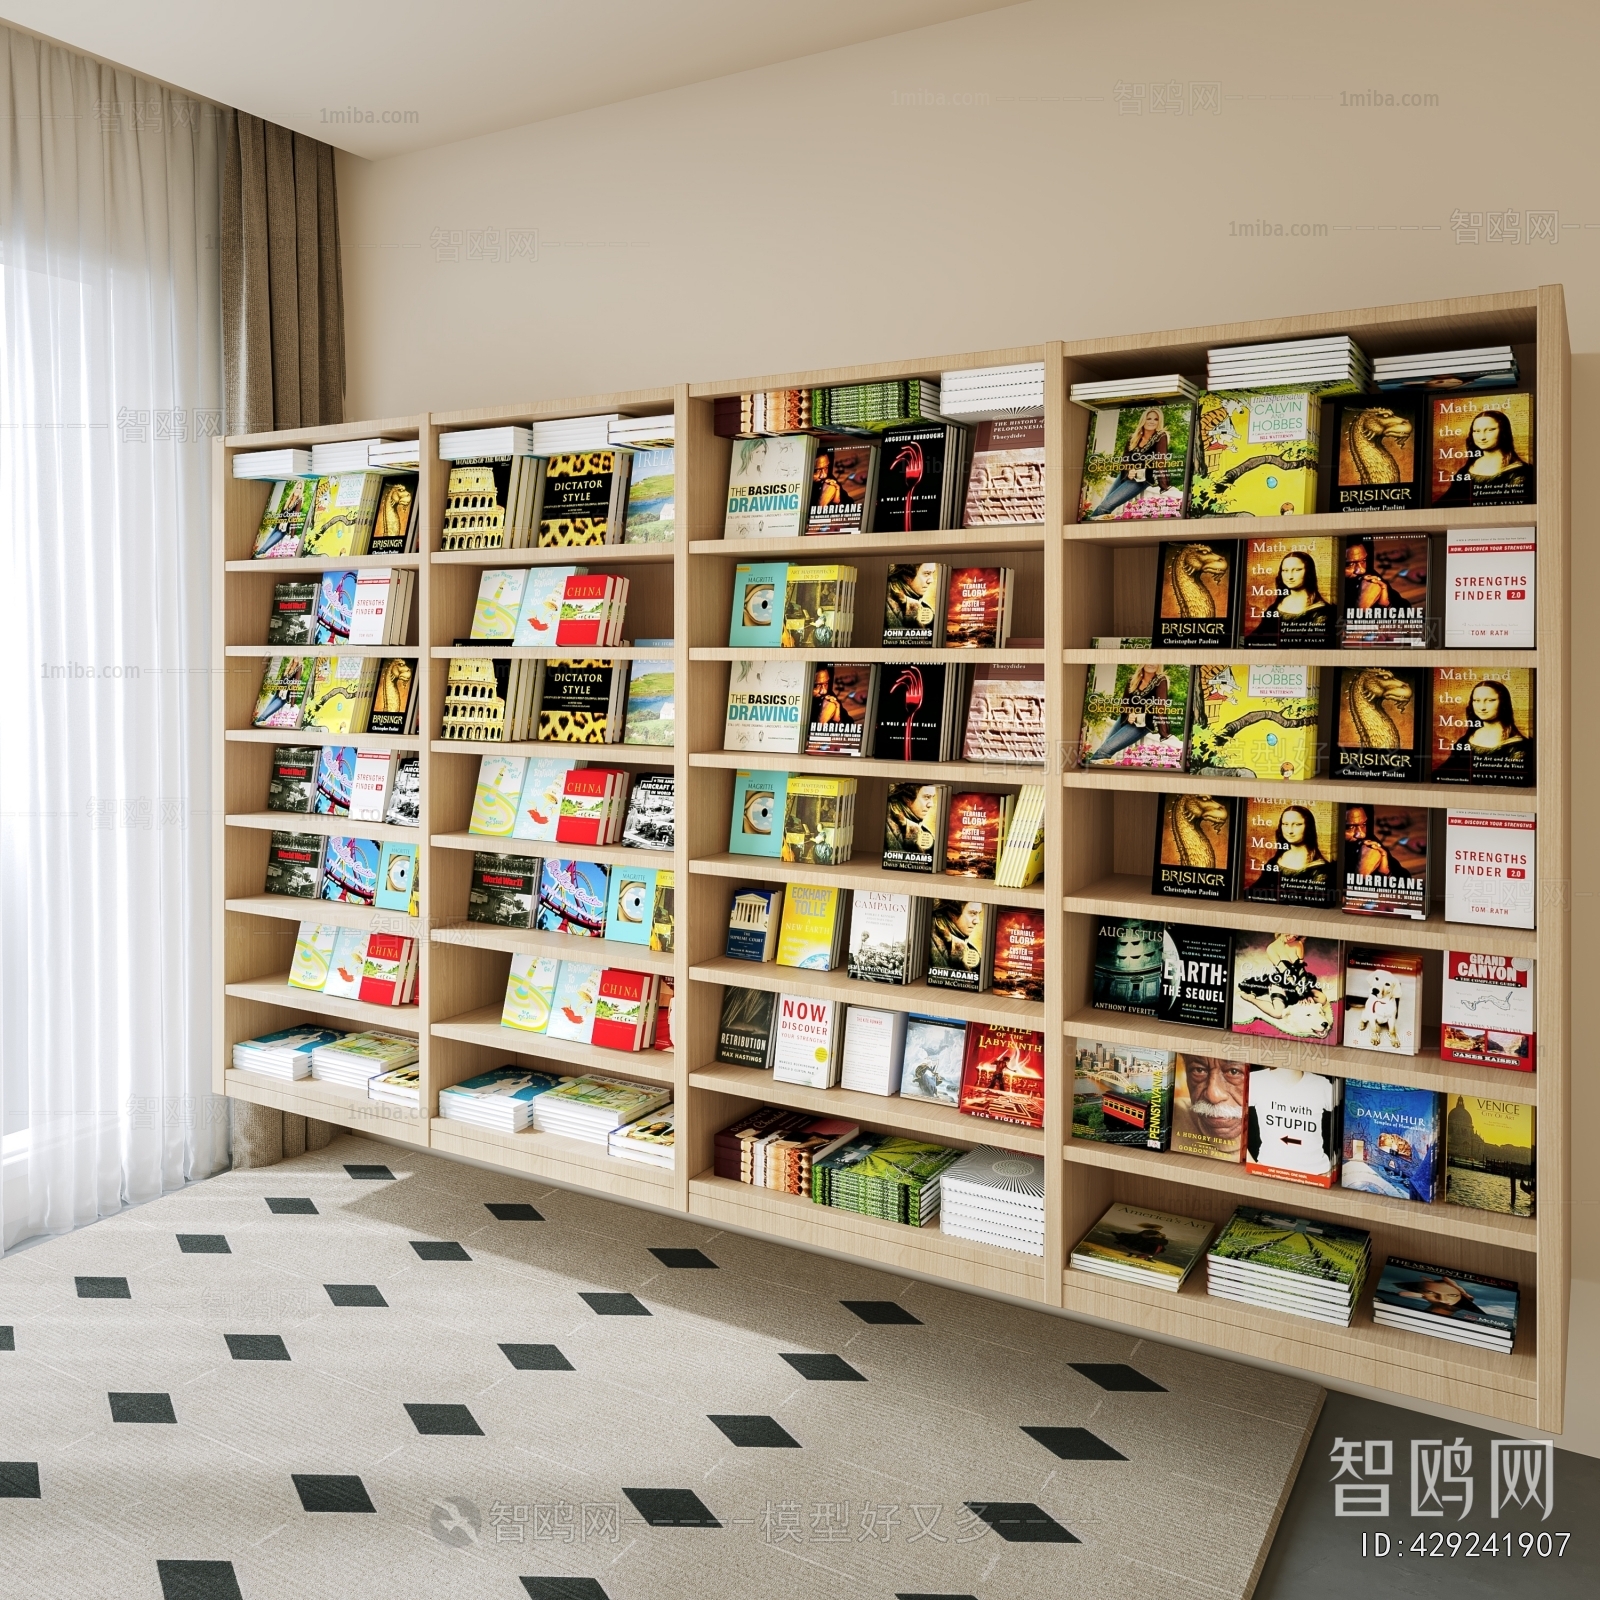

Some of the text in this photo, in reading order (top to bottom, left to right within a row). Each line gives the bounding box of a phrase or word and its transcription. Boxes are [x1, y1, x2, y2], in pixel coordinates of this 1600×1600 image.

[1254, 401, 1302, 415] CALVIN
[1439, 398, 1512, 414] Math and
[993, 423, 1045, 433] PELOPONNESIA
[1252, 417, 1303, 431] HOBBES
[884, 434, 912, 443] AUGUSTEN
[912, 432, 944, 441] BURROUGHS
[992, 433, 1026, 441] Thucydides
[1439, 426, 1462, 437] the
[1088, 451, 1173, 467] Georgia Cooking
[1438, 449, 1482, 460] Mona
[1087, 458, 1184, 474] Oklahoma Kitchen
[1438, 471, 1472, 482] Lisa
[554, 479, 603, 492] DICTATOR
[730, 482, 800, 496] THE BASICS OF
[562, 491, 591, 503] STYLE
[1339, 488, 1412, 505] BRISINGR
[728, 494, 799, 514] DRAWING
[1382, 504, 1405, 512] Paolini
[372, 539, 403, 550] BRISINGR
[1252, 540, 1316, 553] Math and
[1251, 563, 1273, 575] the
[1454, 575, 1528, 587] STRENGTHS
[566, 586, 602, 597] CHINA
[962, 589, 987, 598] GLORY
[1251, 585, 1290, 596] Mona
[1454, 590, 1521, 601] FINDER 2.0
[1250, 607, 1280, 618] Lisa
[1346, 607, 1424, 619] HURRICANE
[1161, 622, 1225, 637] BRISINGR
[554, 673, 603, 683] DICTATOR
[1252, 673, 1303, 686] HOBBES
[562, 685, 591, 694] STYLE
[730, 694, 800, 705] THE BASICS OF
[372, 715, 403, 726] BRISINGR
[728, 705, 799, 723] DRAWING
[356, 774, 385, 782] STRENGTHS
[566, 782, 602, 794] CHINA
[641, 782, 669, 791] AIRCRAFT
[883, 851, 933, 862] JOHN ADAMS
[1454, 850, 1527, 865] STRENGTHS
[546, 859, 576, 894] Roller
[622, 872, 646, 881] MAGRITTE
[1454, 864, 1522, 878] FINDER 2.0
[482, 874, 502, 884] World
[503, 876, 517, 886] War
[1346, 872, 1424, 891] HURRICANE
[791, 887, 832, 902] ECKHART
[869, 891, 895, 902] LAST
[795, 900, 827, 917] TOLLE
[854, 901, 907, 913] CAMPAIGN
[785, 922, 830, 935] NEW EARTH
[1098, 925, 1164, 943] AUGUSTUS
[369, 945, 399, 959] CHINA
[1469, 953, 1506, 968] GRAND
[1164, 958, 1228, 986] EARTH:
[1457, 962, 1517, 982] CANYON
[602, 982, 639, 998] CHINA
[1162, 984, 1182, 998] THE
[1185, 986, 1225, 1003] SEQUEL
[782, 1000, 829, 1026] NOW,
[1094, 1001, 1156, 1016] ANTHONY EVERITT
[781, 1020, 828, 1036] DISCOVER
[720, 1033, 767, 1051] RETRIBUTION
[781, 1032, 827, 1045] YOUR STRENGTHS
[1009, 1033, 1024, 1041] THE
[978, 1035, 1042, 1053] LABYRINTH
[721, 1050, 763, 1063] MAX HASTINGS
[1453, 1052, 1519, 1065] JAMES KAISER
[1149, 1070, 1164, 1139] PENNSYLVANIA
[1271, 1100, 1313, 1117] I'm with
[1477, 1098, 1520, 1116] VENICE
[730, 1109, 771, 1132] DISCOVER
[753, 1110, 788, 1129] Chocolate
[971, 1111, 1032, 1126] RICK RIORDAN
[1265, 1114, 1318, 1134] STUPID
[1356, 1107, 1426, 1128] DAMANHUR
[1373, 1119, 1392, 1127] Temples
[1182, 1132, 1212, 1143] HUNGRY
[1213, 1137, 1237, 1147] HEART
[1178, 1144, 1208, 1155] GORDON
[1118, 1205, 1208, 1231] America's Art
[1389, 1257, 1411, 1267] THE
[1412, 1261, 1462, 1277] MOMENT
[1462, 1272, 1476, 1280] IT
[1478, 1316, 1510, 1328] McNally
